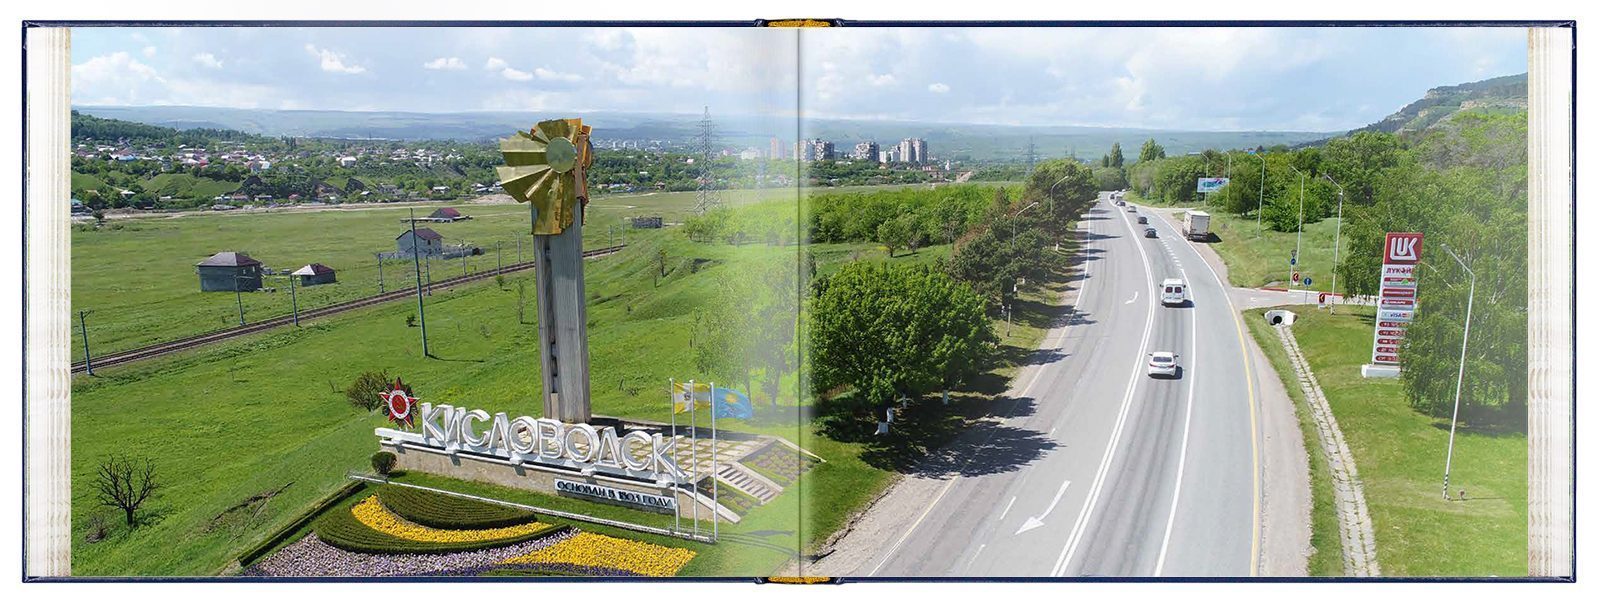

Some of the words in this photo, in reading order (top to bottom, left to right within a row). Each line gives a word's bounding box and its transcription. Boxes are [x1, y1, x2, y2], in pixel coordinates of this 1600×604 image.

[421, 402, 689, 481] КИСЛОВОДСК
[557, 481, 606, 496] ОСНОВАН
[608, 489, 616, 498] В
[643, 497, 671, 507] ГОДУ
